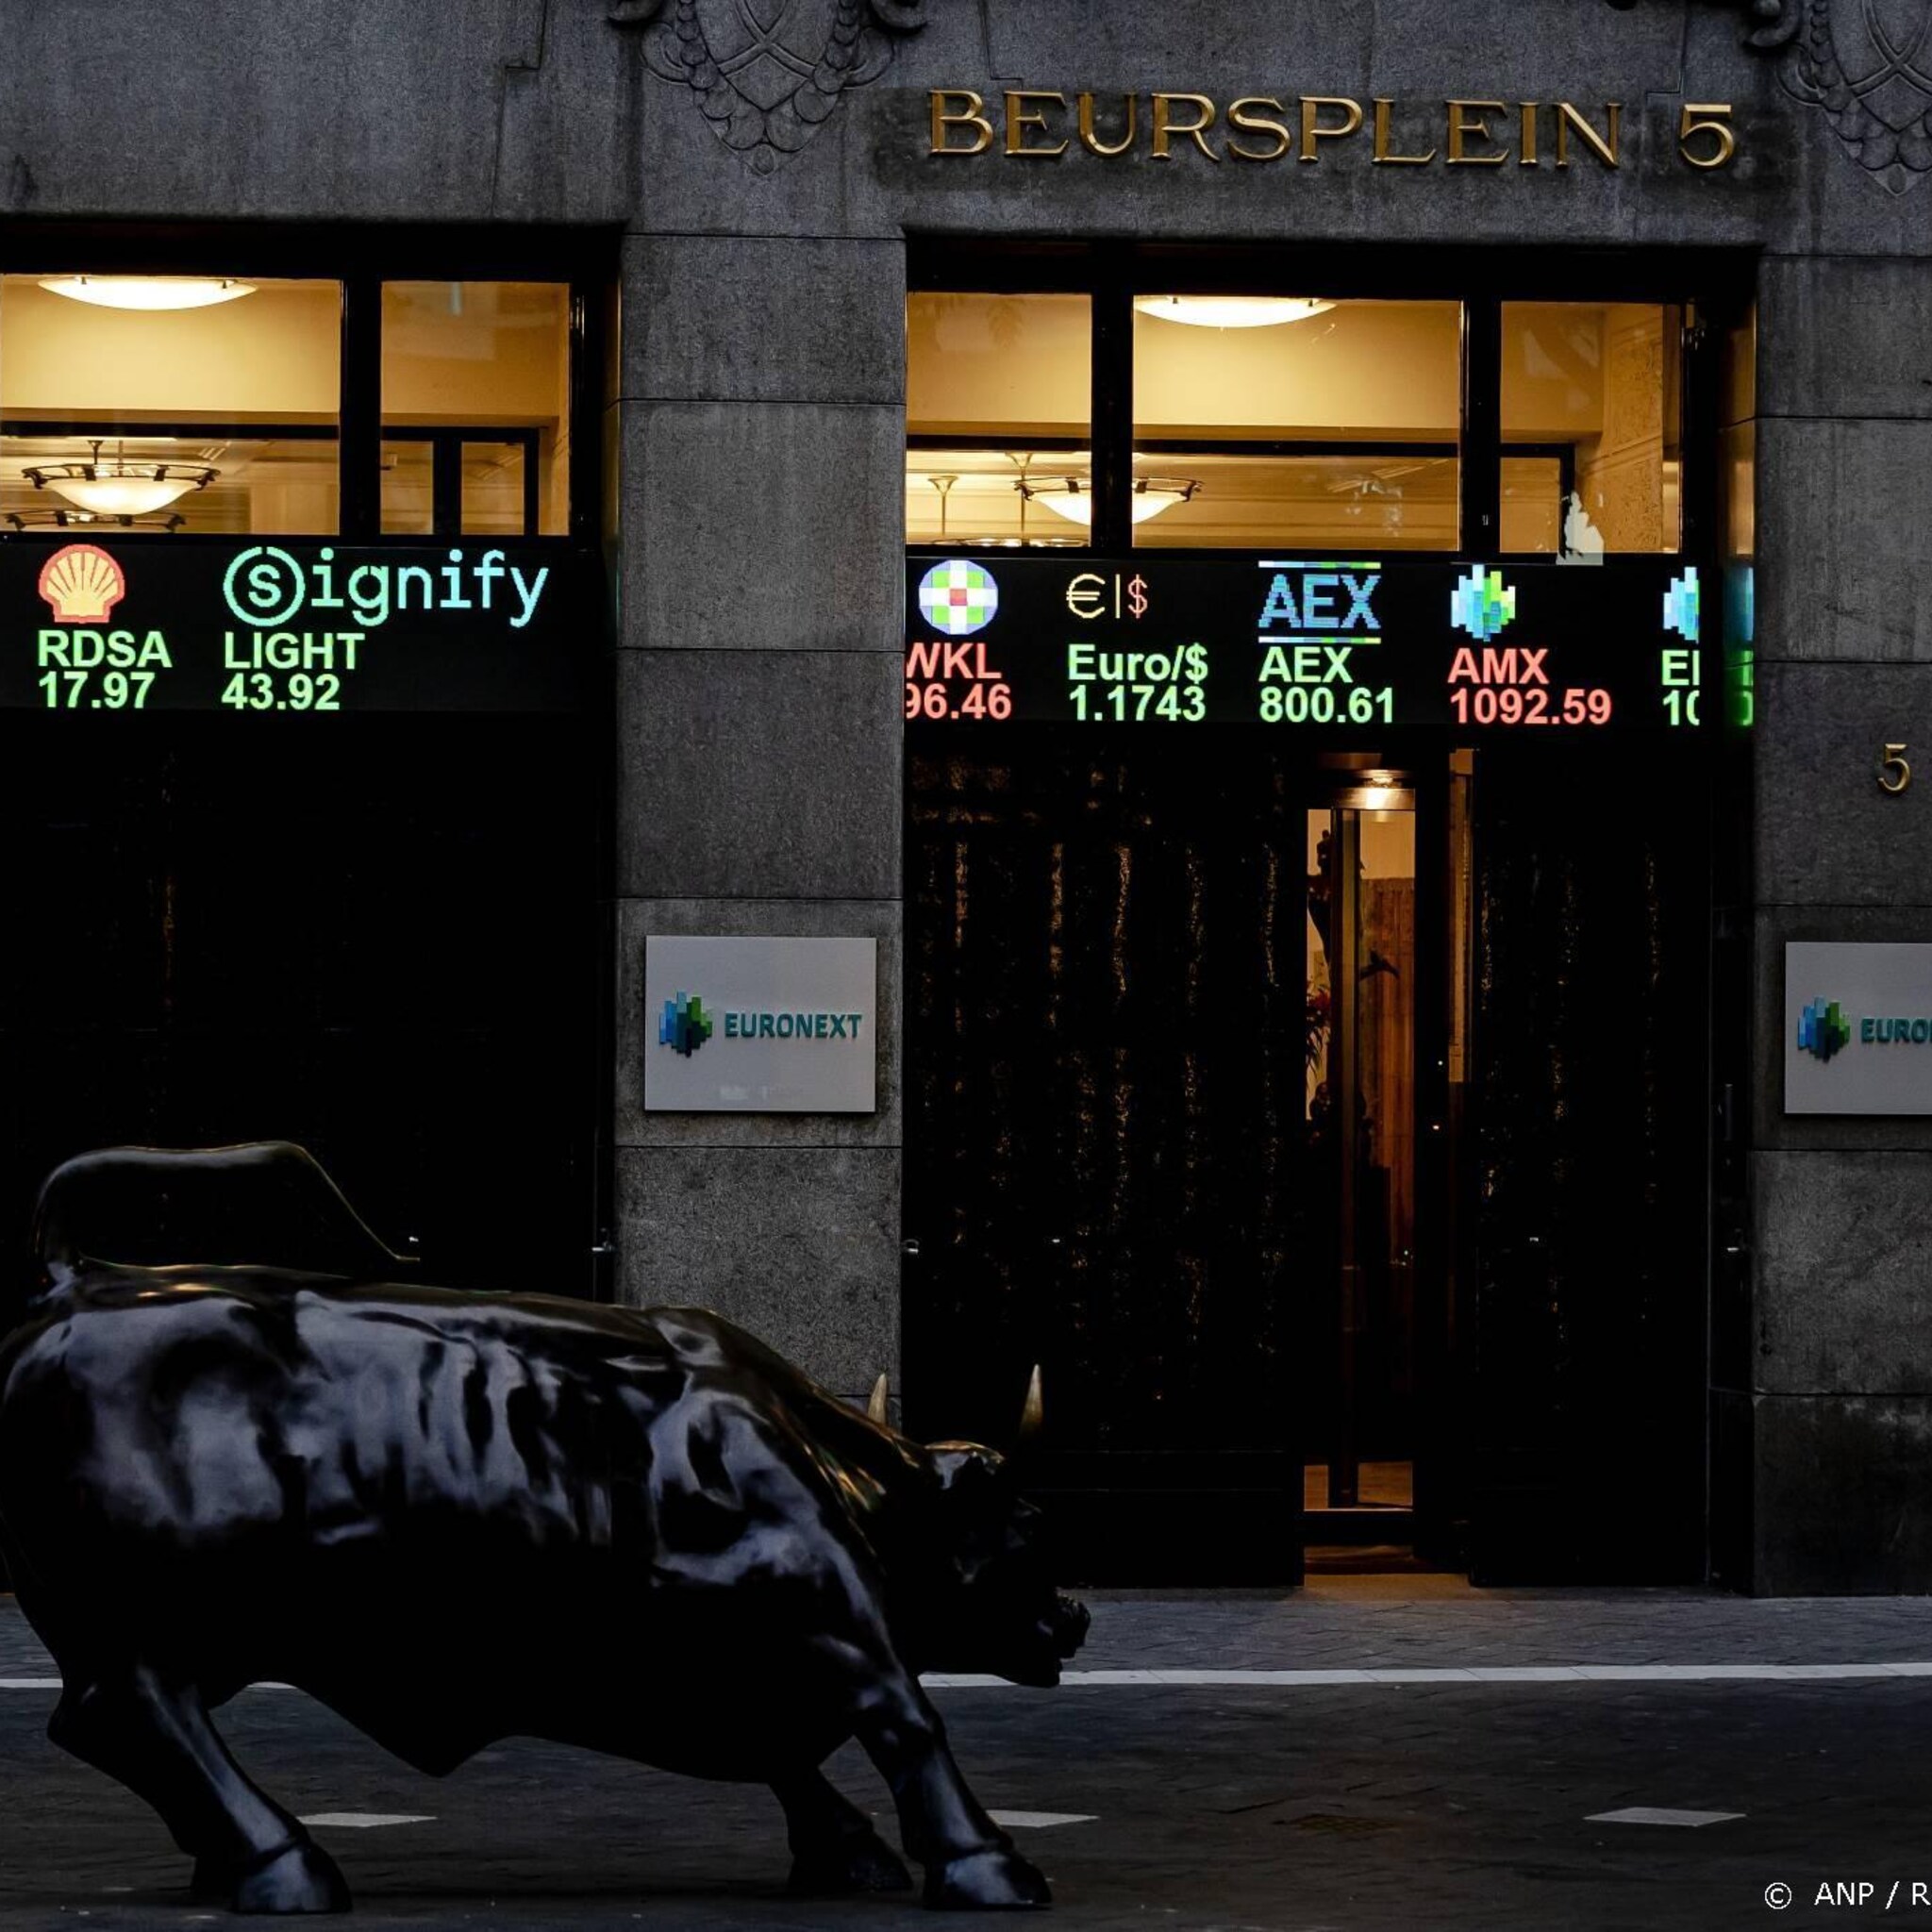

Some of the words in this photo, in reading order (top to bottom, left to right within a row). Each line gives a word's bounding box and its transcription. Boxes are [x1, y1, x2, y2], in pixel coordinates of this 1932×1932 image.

[928, 88, 1622, 169] BEURSPLEIN
[1679, 103, 1735, 168] 5
[1257, 574, 1382, 629] AEX
[38, 630, 173, 669] RDSA
[225, 631, 366, 670] LIGHT
[906, 641, 1003, 679] WKL
[1067, 642, 1208, 686] Euro/$
[1258, 646, 1357, 684] AEX
[1447, 647, 1550, 685] AMX
[38, 671, 156, 709] 17.97
[221, 672, 341, 711] 43.92
[906, 682, 1012, 720] 96.46
[1069, 684, 1207, 722] 1.1743
[1258, 686, 1393, 724] 800.61
[1450, 688, 1612, 724] 1092.59
[1877, 742, 1910, 791] 5
[724, 1012, 863, 1039] EURONEXT
[1860, 1018, 1932, 1043] EURO
